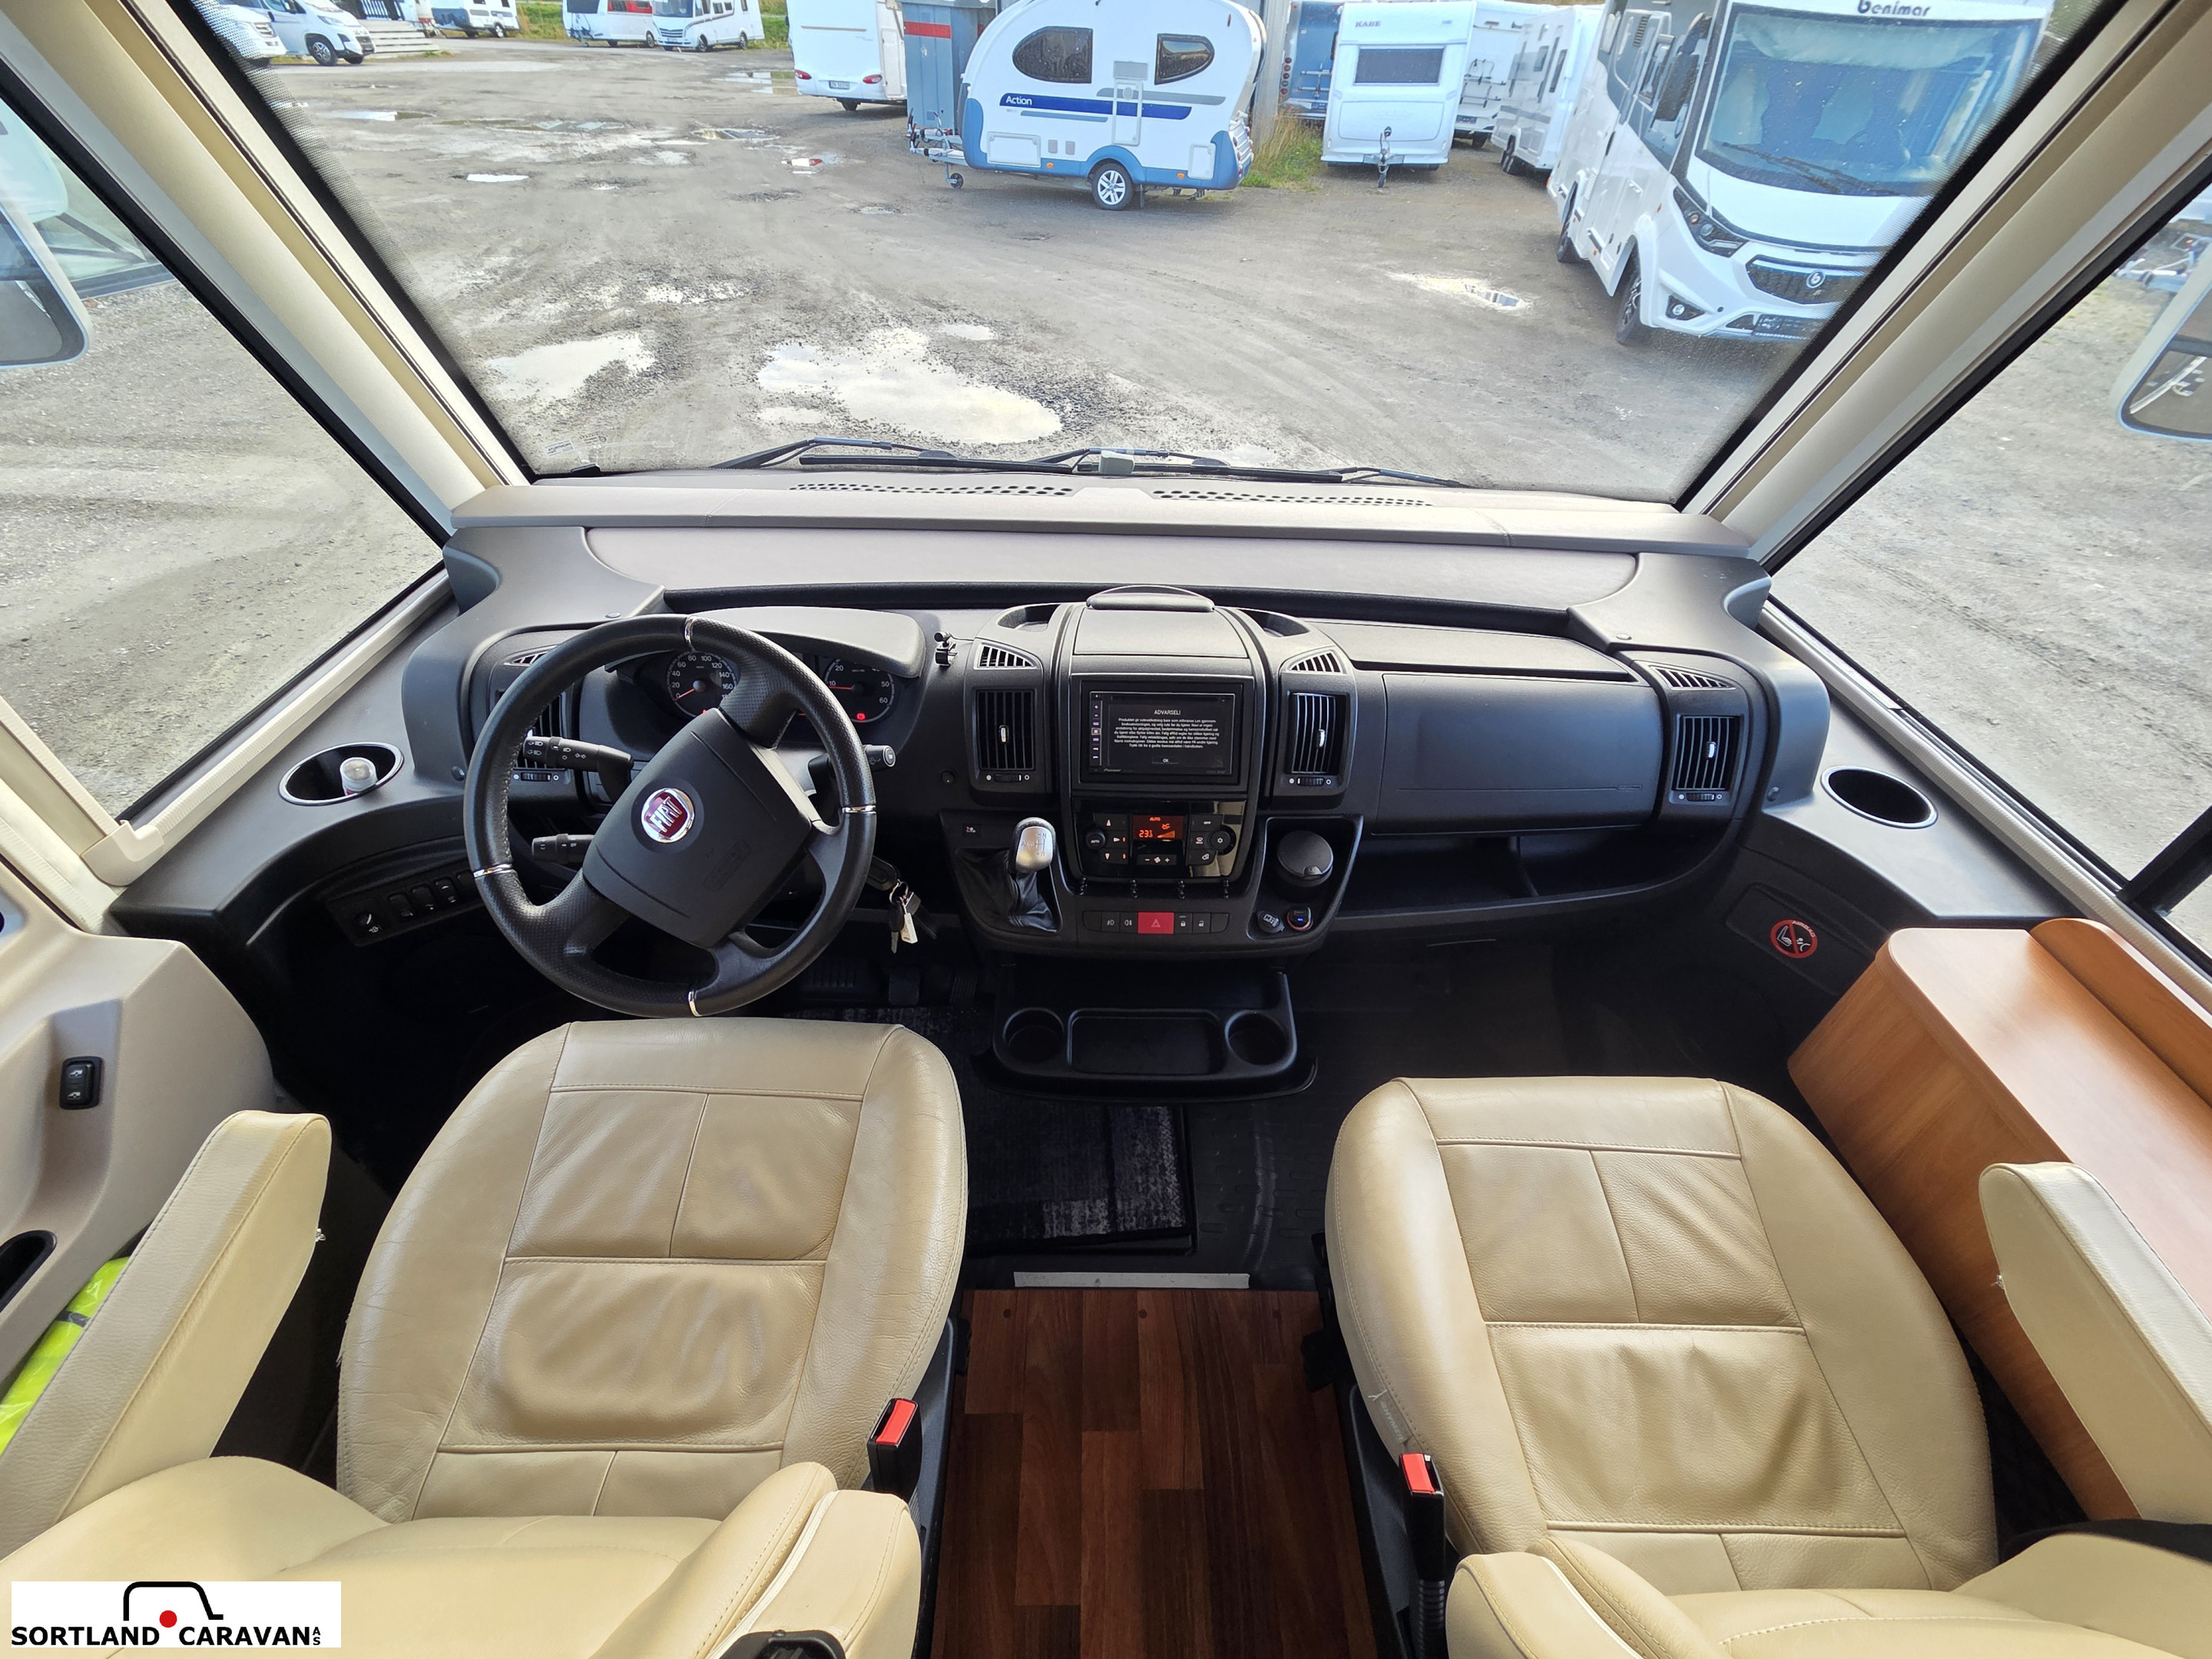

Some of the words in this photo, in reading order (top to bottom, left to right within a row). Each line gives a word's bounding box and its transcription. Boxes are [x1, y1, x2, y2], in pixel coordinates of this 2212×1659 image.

[1005, 95, 1032, 105] Action
[649, 796, 683, 833] FIAT
[1791, 920, 1816, 938] AIRBAG
